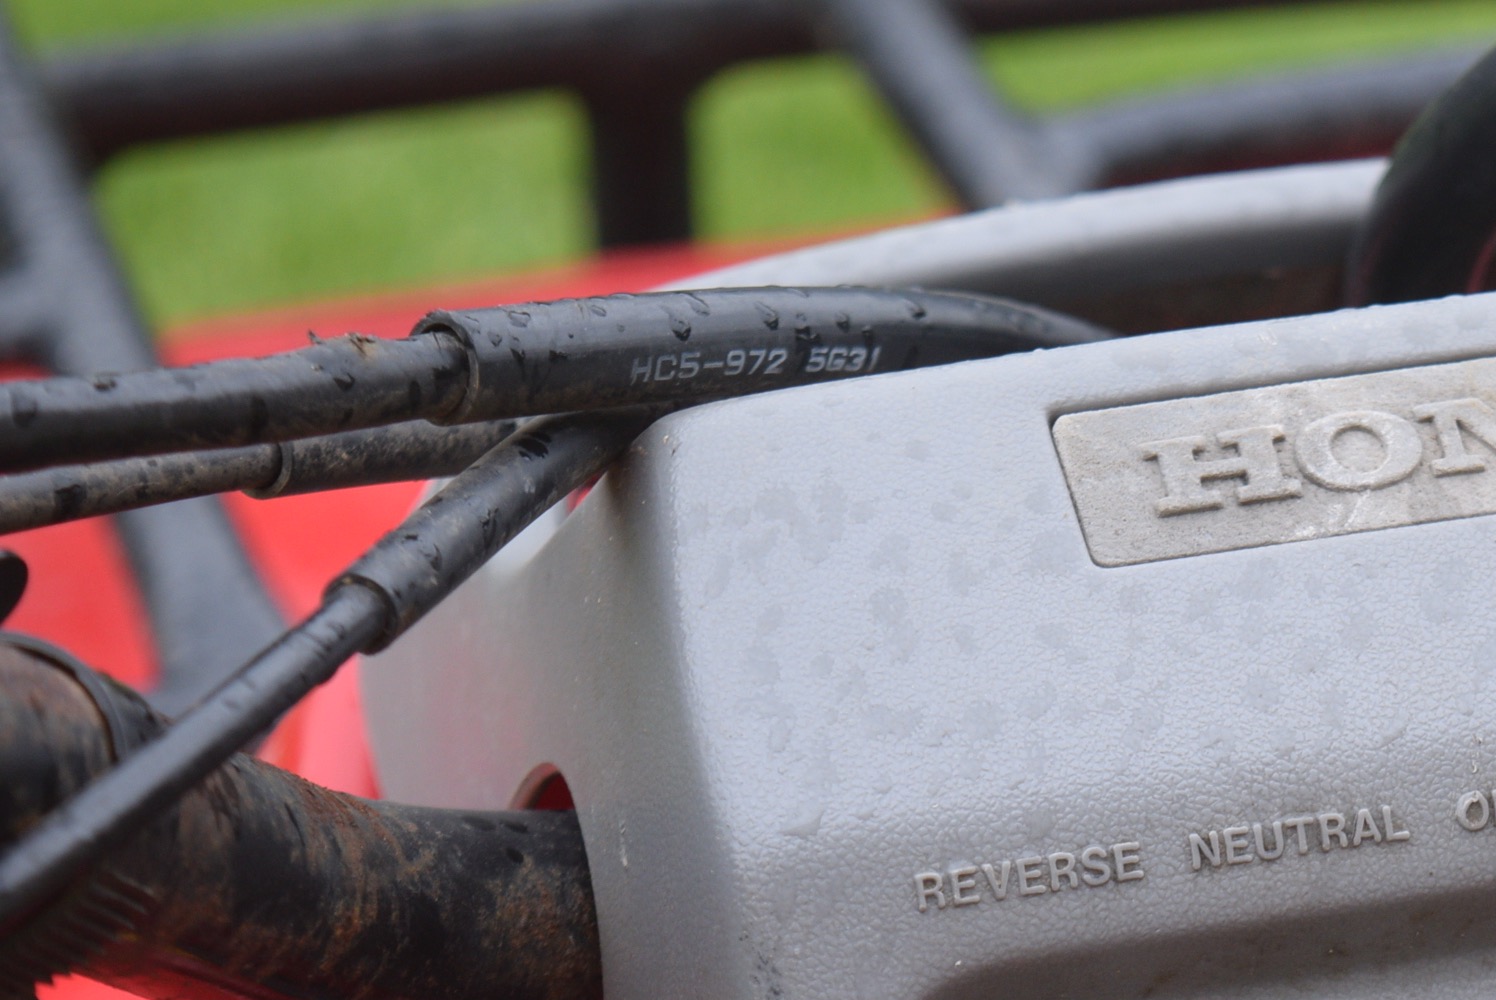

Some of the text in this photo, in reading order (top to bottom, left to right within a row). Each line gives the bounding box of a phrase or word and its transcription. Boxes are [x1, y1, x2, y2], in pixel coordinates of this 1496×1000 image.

[629, 350, 788, 385] HC5-972
[914, 841, 1146, 914] REVERSE
[1188, 804, 1410, 872] NEUTRAL
